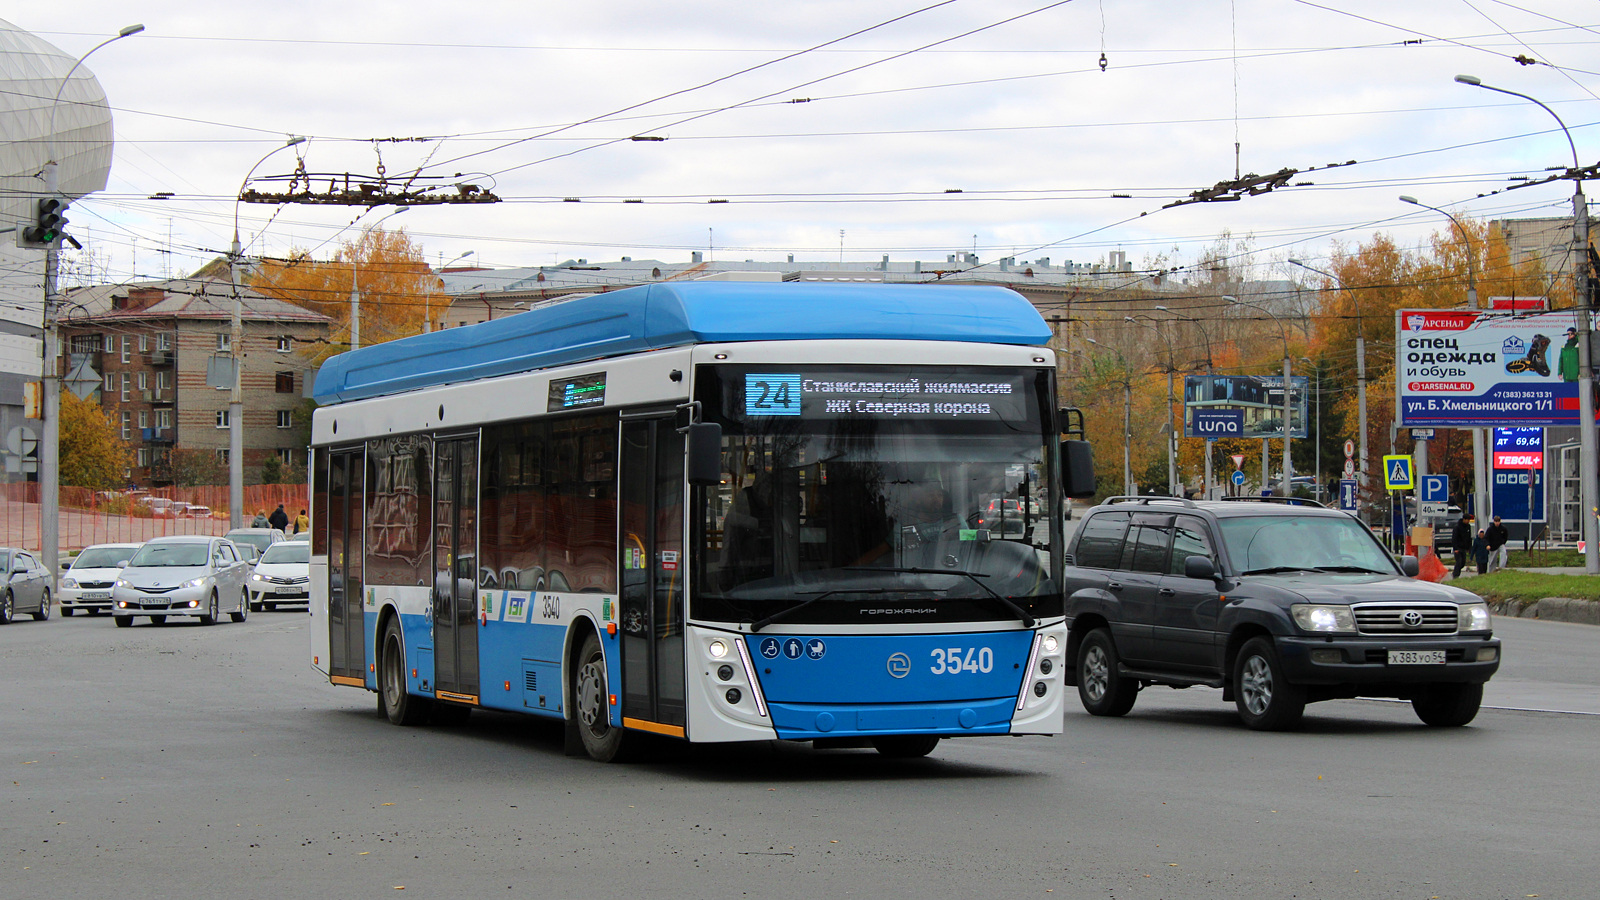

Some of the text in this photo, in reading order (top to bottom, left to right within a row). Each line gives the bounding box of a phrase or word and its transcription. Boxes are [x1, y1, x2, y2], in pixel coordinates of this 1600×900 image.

[1424, 320, 1464, 328] АРСЕНАЛ
[1407, 338, 1458, 351] спец
[1407, 352, 1496, 365] одежда
[1407, 365, 1466, 379] и обувь
[803, 378, 1012, 394] Станиславский жилмассив
[755, 380, 792, 408] 24
[1502, 391, 1522, 399] (383)
[826, 399, 991, 416] ЖК Северная корона
[1408, 399, 1553, 413] ул. Б. Хмельницкого 1/1
[1496, 437, 1541, 446] ДТ 69,64
[542, 595, 560, 619] 3540
[930, 647, 994, 675] 3540
